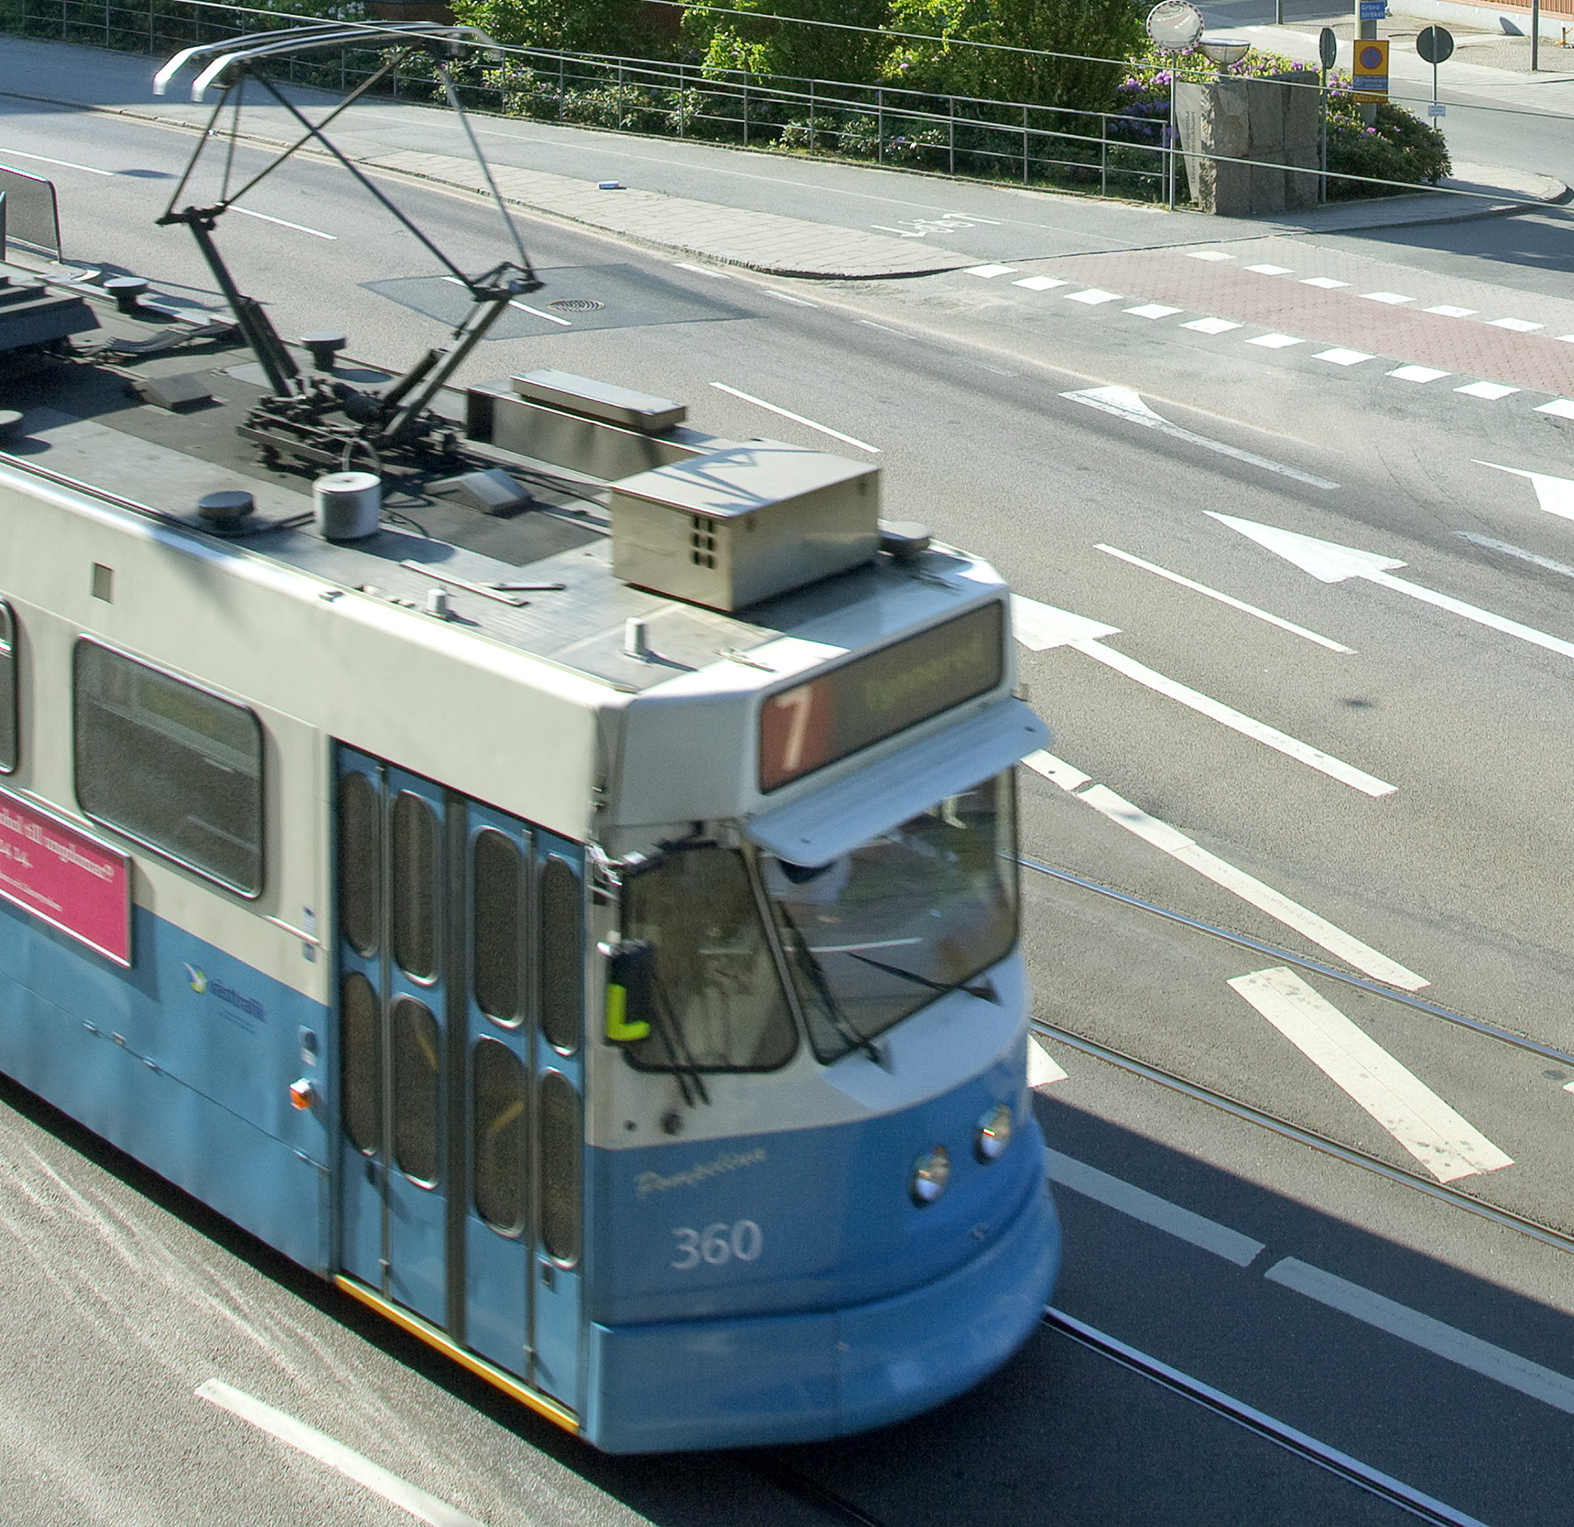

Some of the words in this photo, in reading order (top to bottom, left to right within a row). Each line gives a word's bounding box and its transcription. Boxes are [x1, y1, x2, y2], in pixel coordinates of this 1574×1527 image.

[775, 685, 812, 770] 7
[24, 823, 43, 845] till
[43, 835, 115, 883] ungdomar?
[671, 1219, 763, 1270] 360
